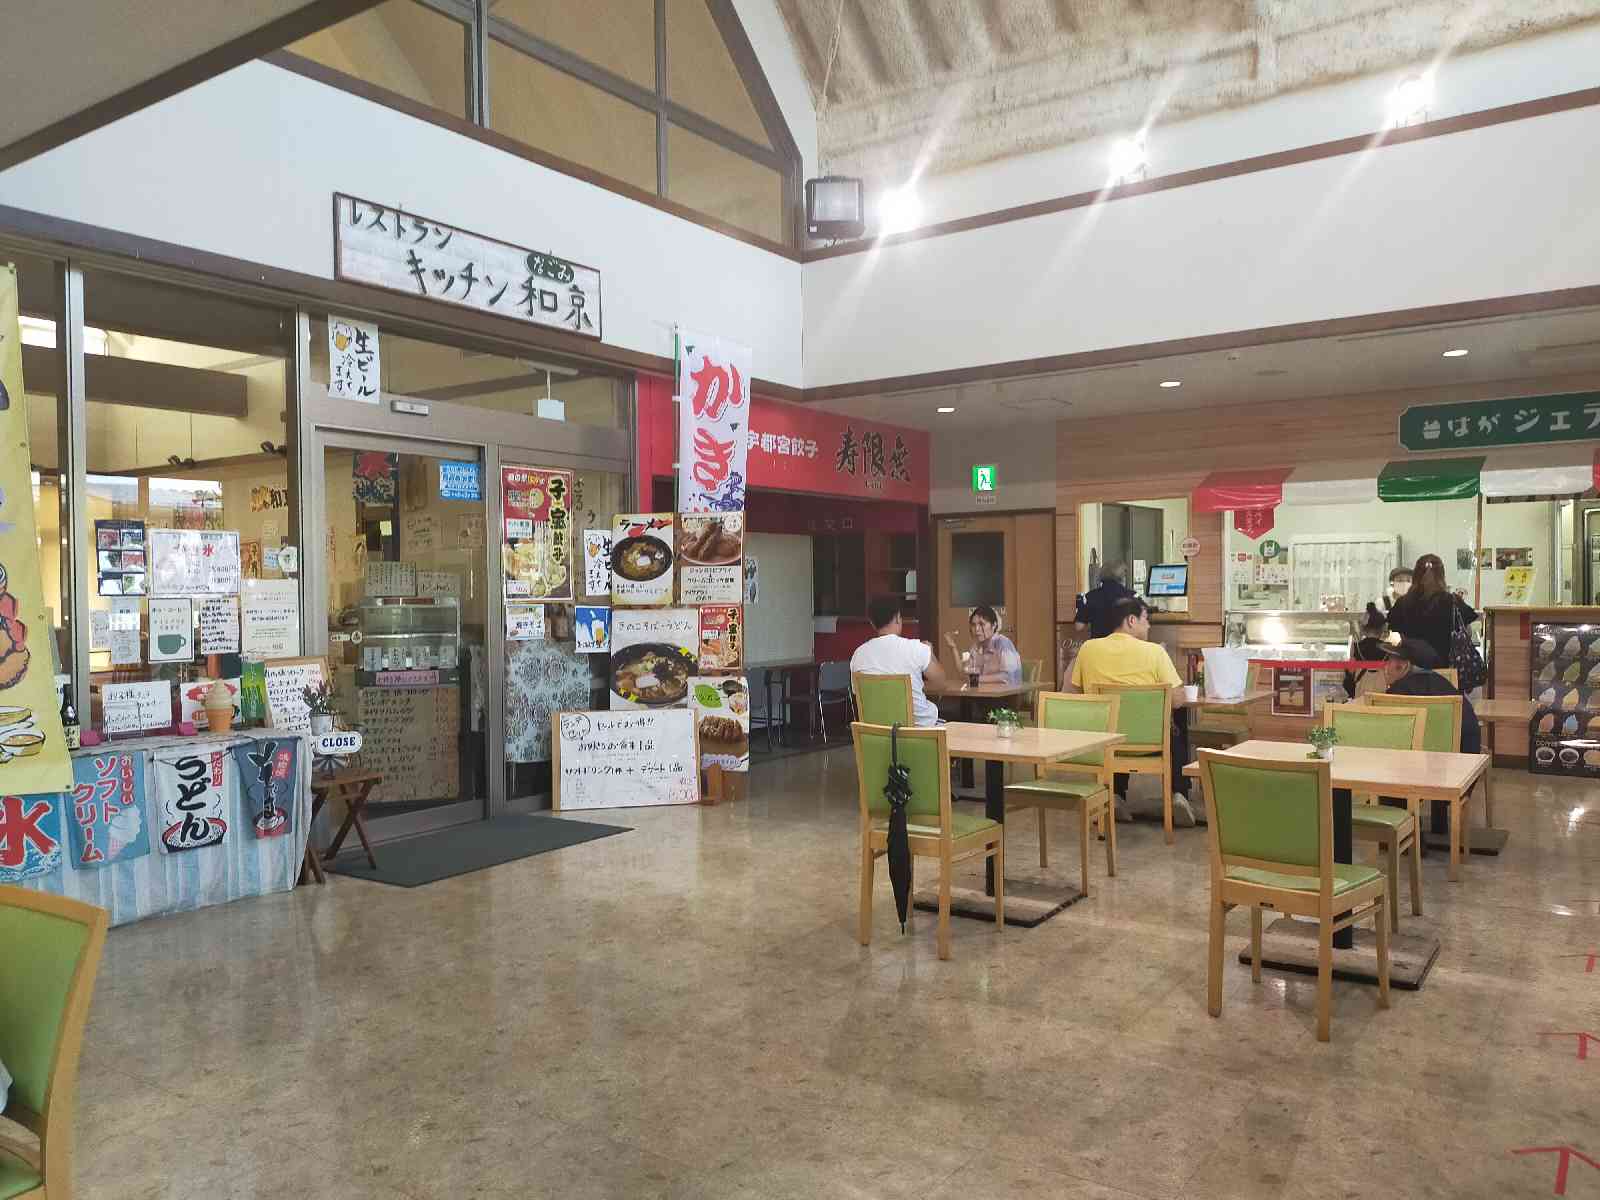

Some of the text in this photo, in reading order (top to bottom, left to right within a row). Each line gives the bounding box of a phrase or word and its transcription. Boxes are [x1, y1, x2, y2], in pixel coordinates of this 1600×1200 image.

[351, 199, 453, 250] レストラン
[532, 256, 573, 284] なごみ
[354, 327, 376, 397] 生ビール
[322, 737, 357, 748] CLOSE
[95, 756, 119, 824] ソフト
[121, 754, 134, 805] おいしい
[175, 756, 211, 842] うどん
[73, 783, 104, 863] クリーム
